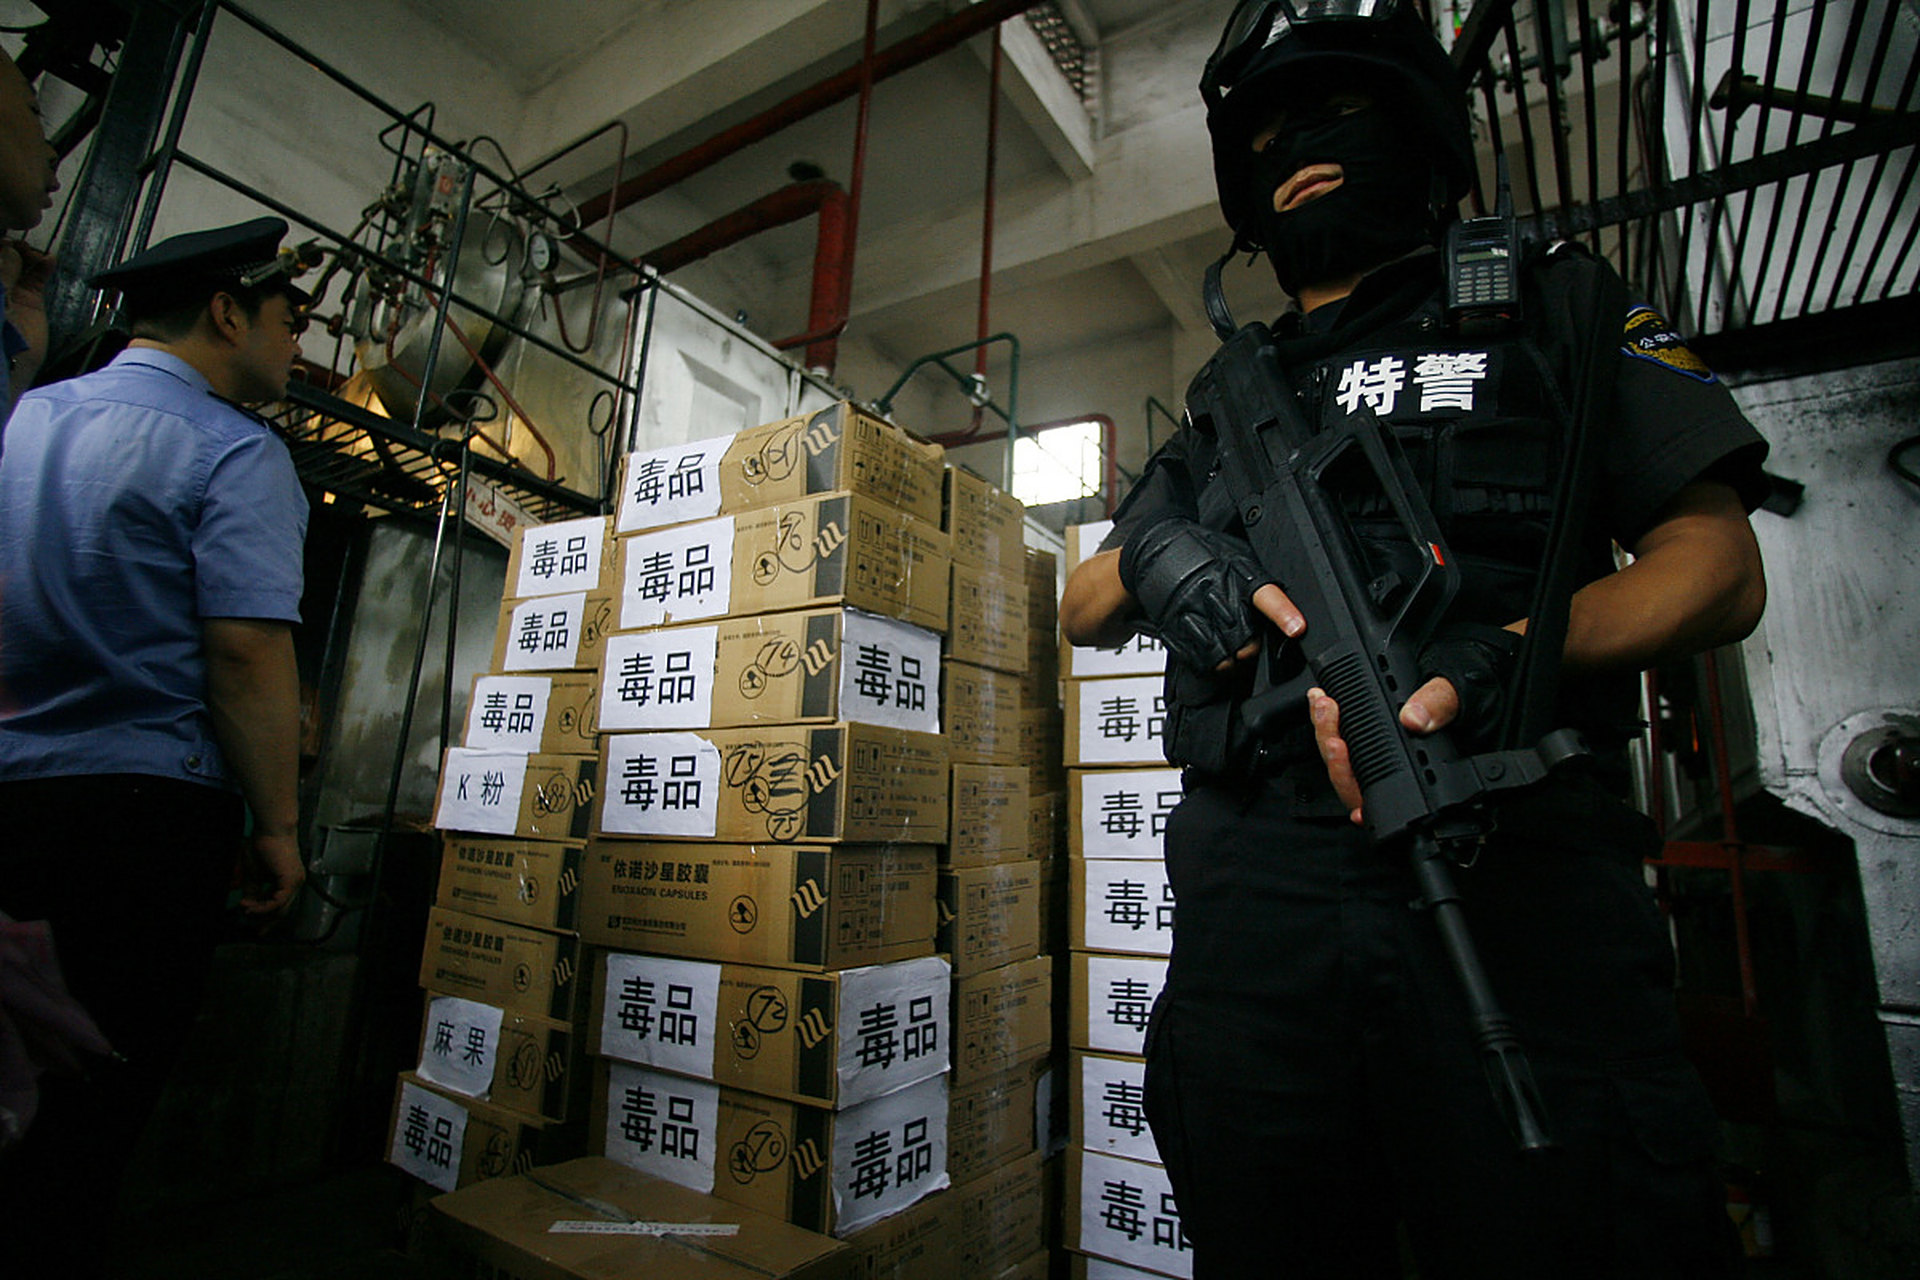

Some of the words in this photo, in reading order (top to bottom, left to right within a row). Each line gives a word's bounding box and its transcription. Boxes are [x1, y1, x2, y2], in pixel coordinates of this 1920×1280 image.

[1336, 352, 1488, 417] 特警
[634, 453, 706, 505] 毒品
[531, 536, 588, 579] 毒品
[638, 545, 715, 604] 毒品
[518, 611, 569, 653] 毒品
[617, 652, 696, 708] 毒品
[855, 643, 926, 711] 毒品
[481, 692, 534, 733] 毒品
[620, 754, 701, 812] 毒品
[660, 888, 708, 901] CAPSULES
[618, 976, 697, 1046] 毒品
[857, 996, 937, 1070] 毒品
[433, 1020, 486, 1067] 麻果
[404, 1104, 453, 1169] 毒品
[620, 1086, 699, 1160] 毒品
[849, 1117, 932, 1200] 毒品
